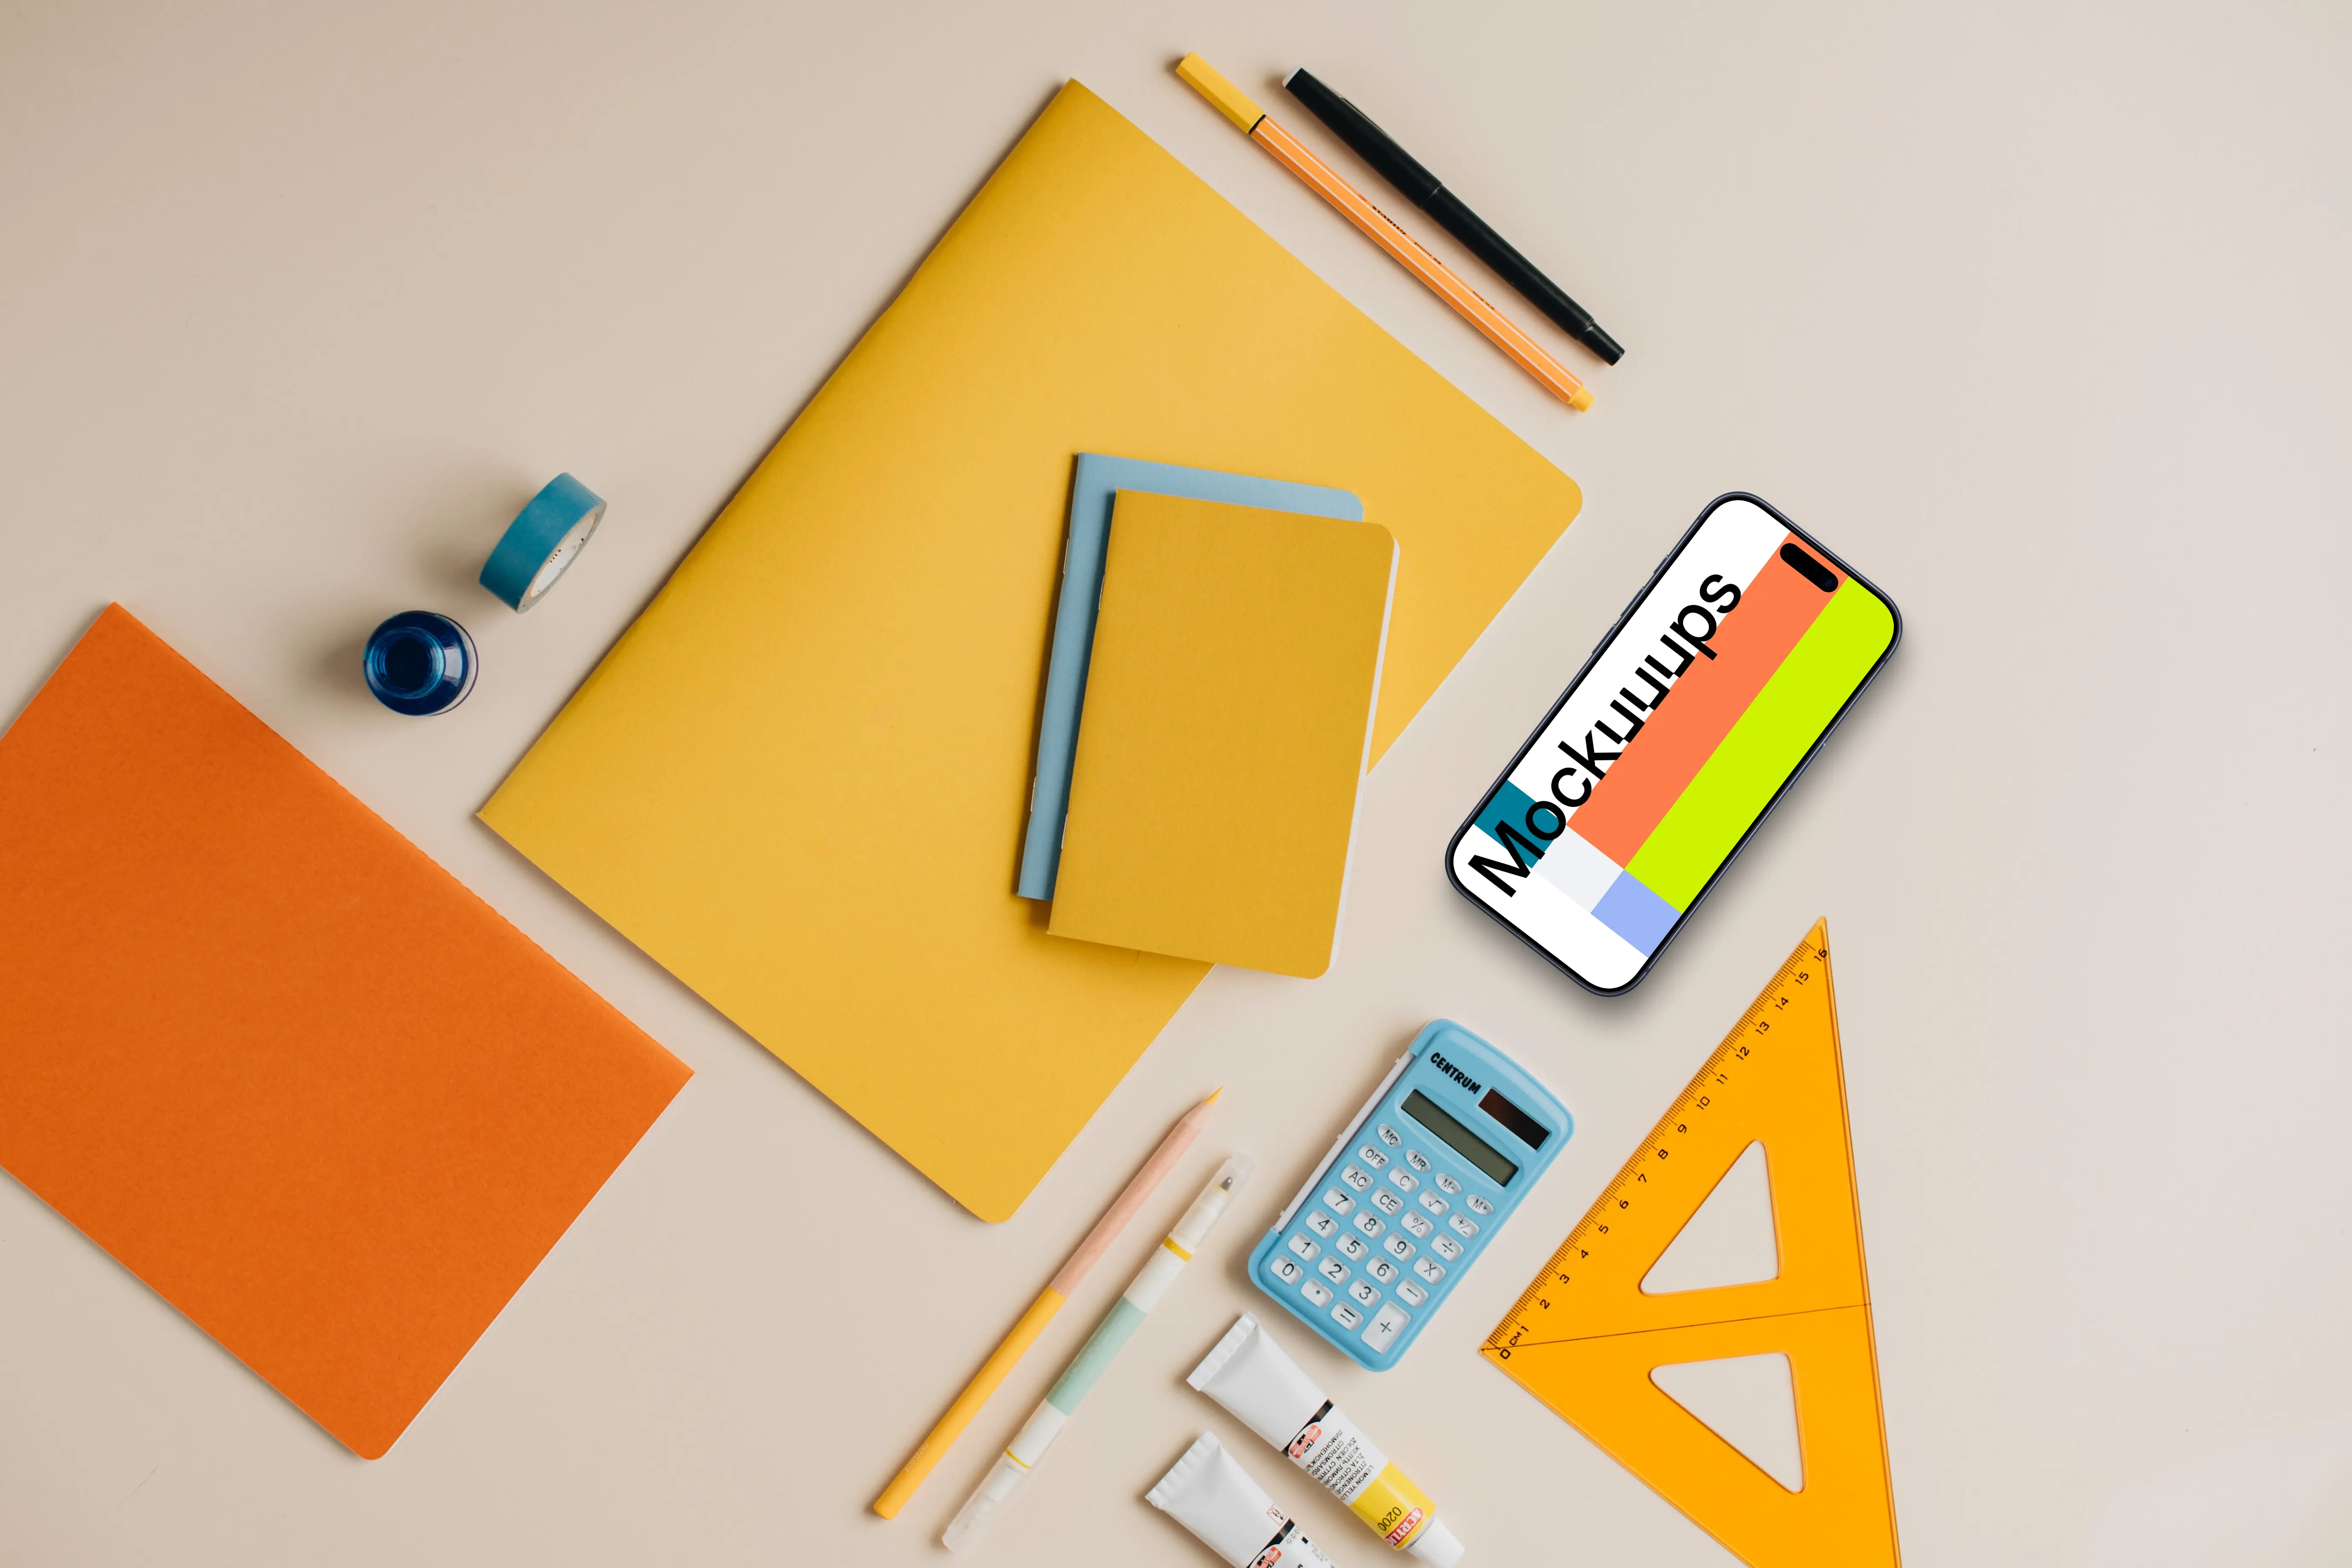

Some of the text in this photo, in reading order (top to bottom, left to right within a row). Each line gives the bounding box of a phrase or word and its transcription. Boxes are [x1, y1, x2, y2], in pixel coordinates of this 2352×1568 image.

[1467, 573, 1742, 898] Mockuuups
[1431, 1053, 1481, 1094] CENTRUM
[1366, 1149, 1385, 1167] OFF
[1400, 1176, 1409, 1186] C
[1382, 1129, 1487, 1210] MC MR M- M+
[1500, 948, 1828, 1359] 0 CM 1 2 3 4 5 6 7 8 9 10 11 12 13 14 15 16
[1347, 1172, 1366, 1188] AC
[1378, 1195, 1397, 1213] CE
[1336, 1194, 1349, 1206] 7
[1364, 1218, 1376, 1231] 8
[1395, 1241, 1407, 1254] 9
[1318, 1219, 1330, 1231] 4
[1348, 1239, 1360, 1253] 5
[1377, 1263, 1389, 1276] 6
[1282, 1263, 1294, 1276] 0
[1302, 1240, 1312, 1253] 1
[1328, 1264, 1342, 1278] 2
[1359, 1286, 1371, 1299] 3
[1316, 1460, 1336, 1482] CYTRYN
[1328, 1466, 1352, 1492] CITRÓNO
[1334, 1460, 1367, 1496] ZITRONENGE
[1355, 1464, 1374, 1485] LEMON
[1376, 1505, 1403, 1532] 0200
[1384, 1507, 1423, 1547] ACRYLIC
